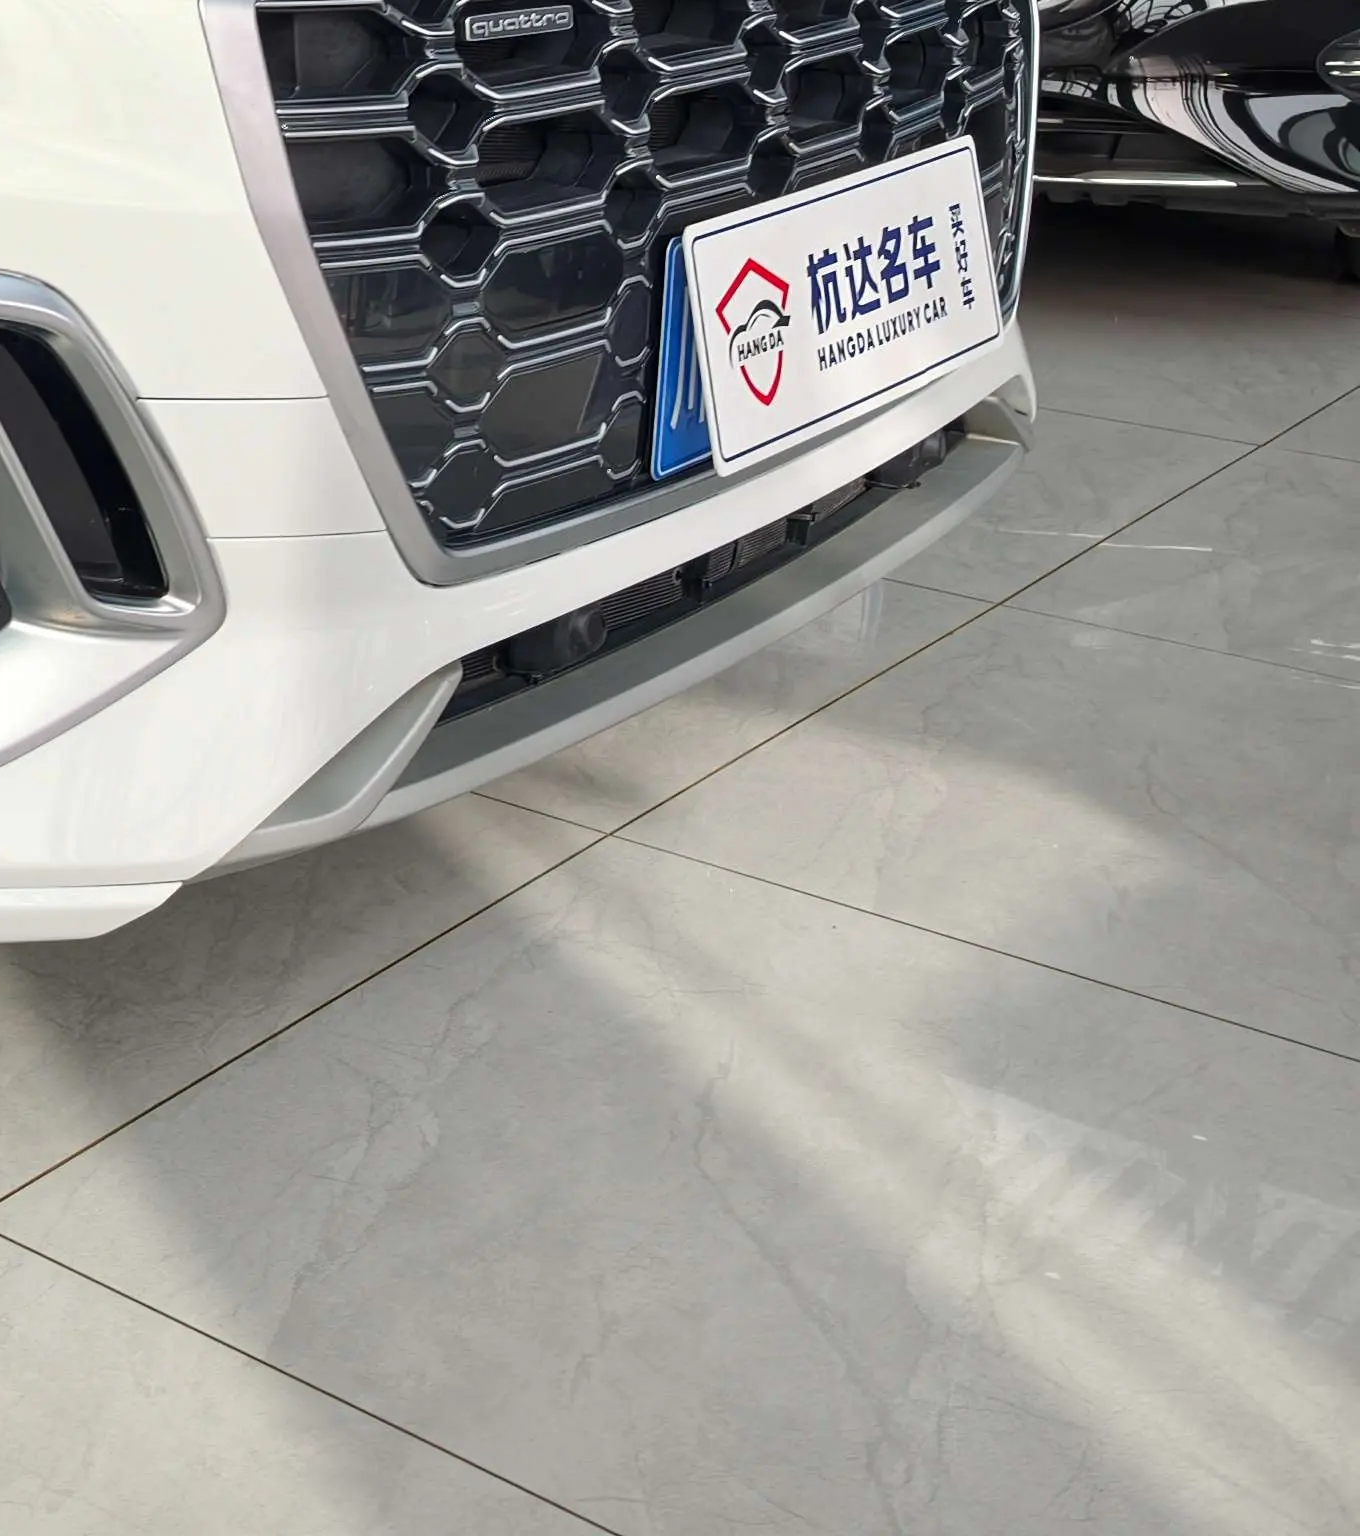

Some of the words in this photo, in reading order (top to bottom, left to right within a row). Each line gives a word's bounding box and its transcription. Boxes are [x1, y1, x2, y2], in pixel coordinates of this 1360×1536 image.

[471, 12, 570, 38] quattro
[807, 215, 941, 335] 杭达名车
[737, 336, 768, 362] HANG
[769, 328, 785, 347] DA
[817, 327, 875, 371] HANGDA
[877, 306, 921, 346] LUXURY
[923, 296, 948, 324] CAR
